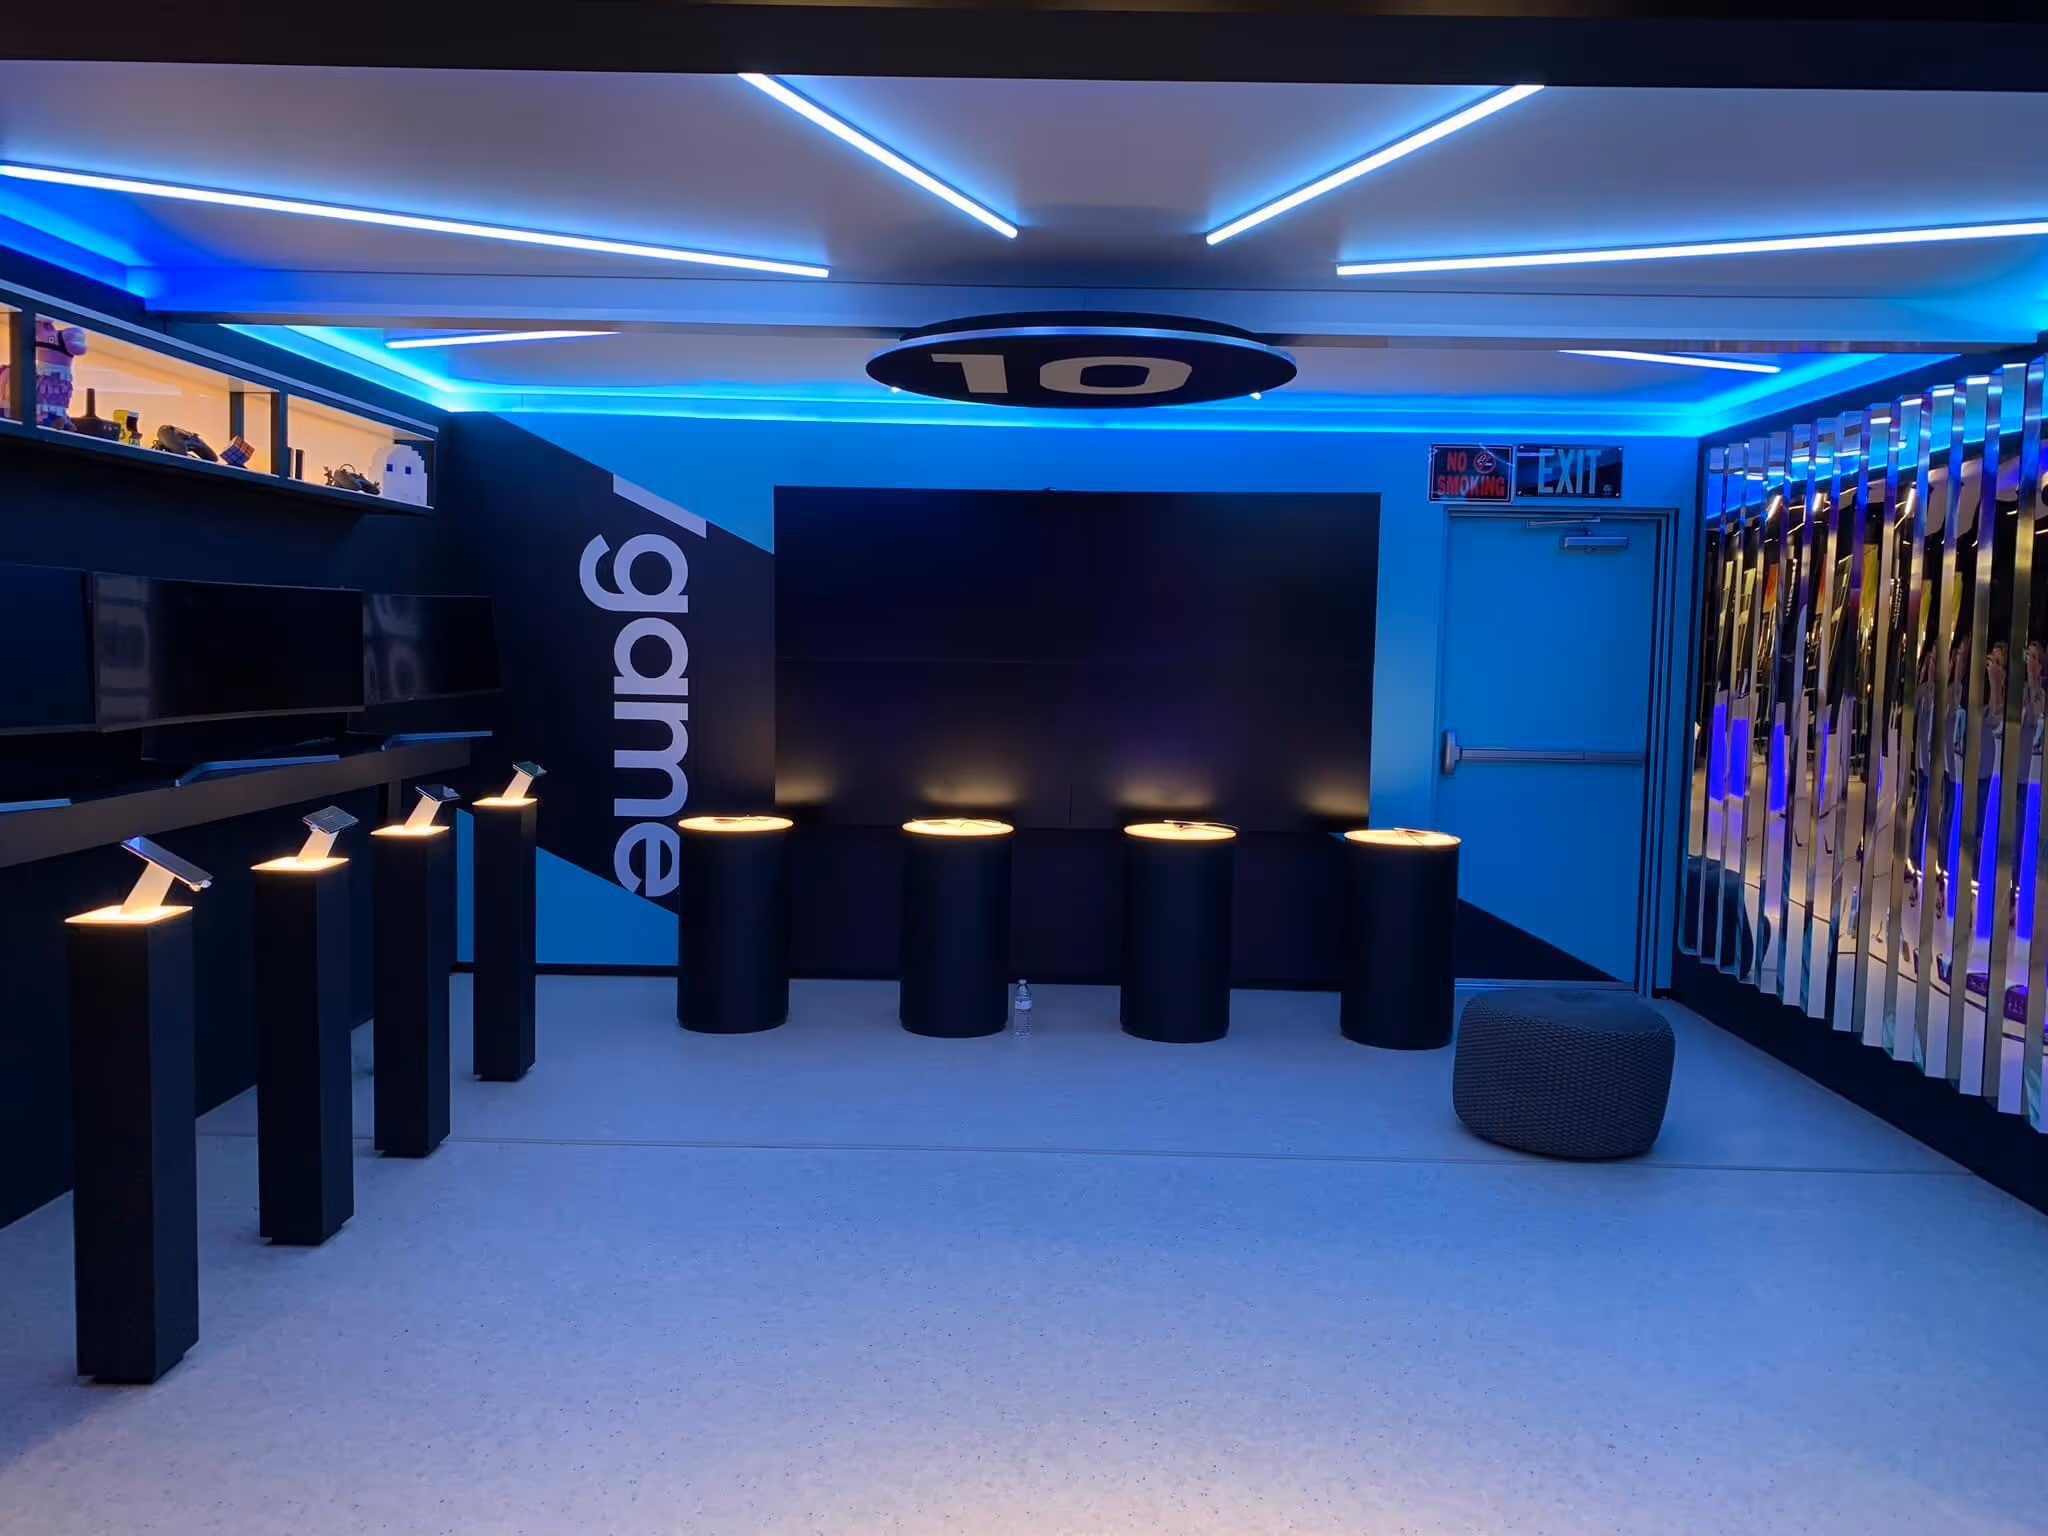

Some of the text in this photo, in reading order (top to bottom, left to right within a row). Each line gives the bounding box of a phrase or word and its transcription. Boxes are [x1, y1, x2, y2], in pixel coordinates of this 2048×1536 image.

[931, 353, 1192, 395] 10
[1446, 451, 1467, 473] NO
[1537, 448, 1602, 494] EXIT
[1437, 475, 1505, 497] SMOKING
